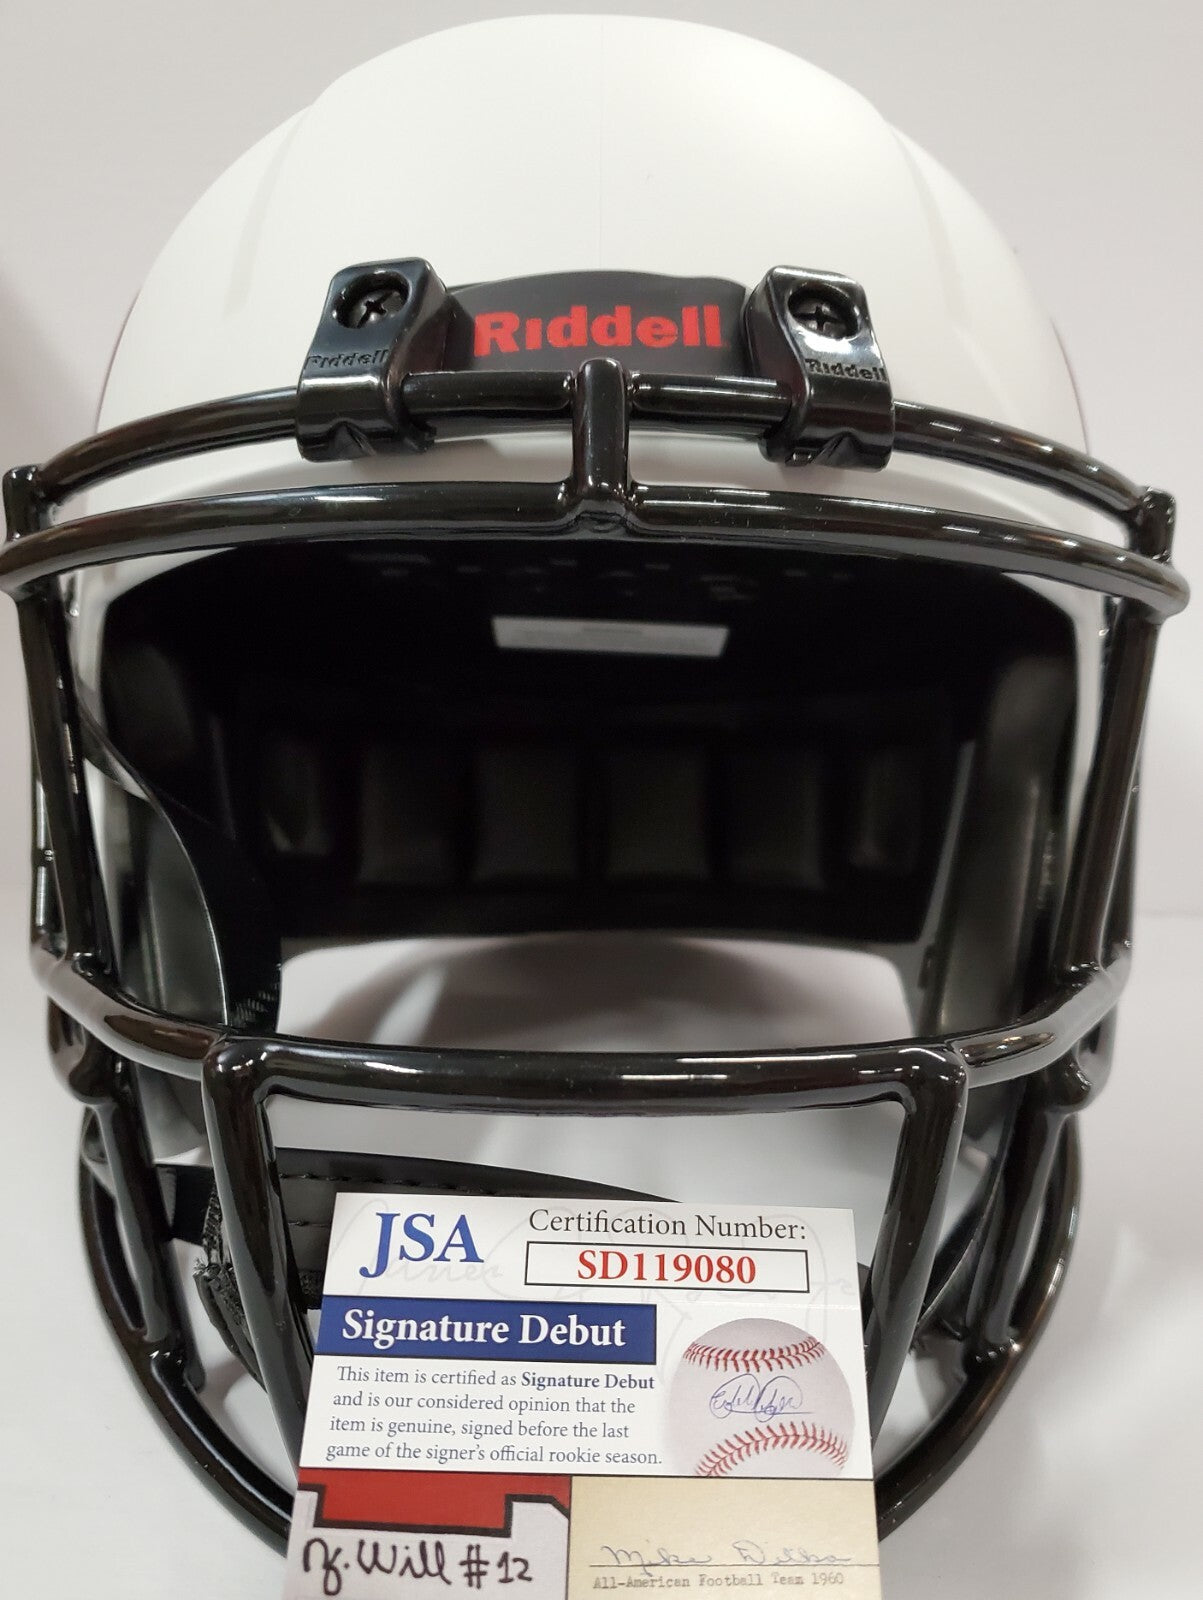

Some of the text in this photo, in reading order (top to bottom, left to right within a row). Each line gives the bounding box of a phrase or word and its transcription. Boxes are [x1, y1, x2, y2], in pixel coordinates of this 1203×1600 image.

[474, 305, 722, 356] Riddell
[804, 358, 887, 382] Riddell
[529, 1209, 806, 1240] Certification Number:
[360, 1212, 484, 1278] JSA
[577, 1250, 756, 1285] SD119080
[342, 1308, 626, 1350] Signature Debut
[337, 1365, 655, 1391] This item is certified as Signature Debut
[333, 1391, 635, 1415] and is our considered opinion that the
[330, 1416, 629, 1440] item is genuine, signed before the last
[326, 1445, 370, 1461] game
[375, 1442, 394, 1457] of
[396, 1443, 421, 1459] the
[490, 1445, 543, 1462] official
[549, 1447, 600, 1463] rookie
[605, 1452, 662, 1464] season.
[357, 1539, 452, 1585] Will
[592, 1572, 845, 1589] All-American Football Team 1960
